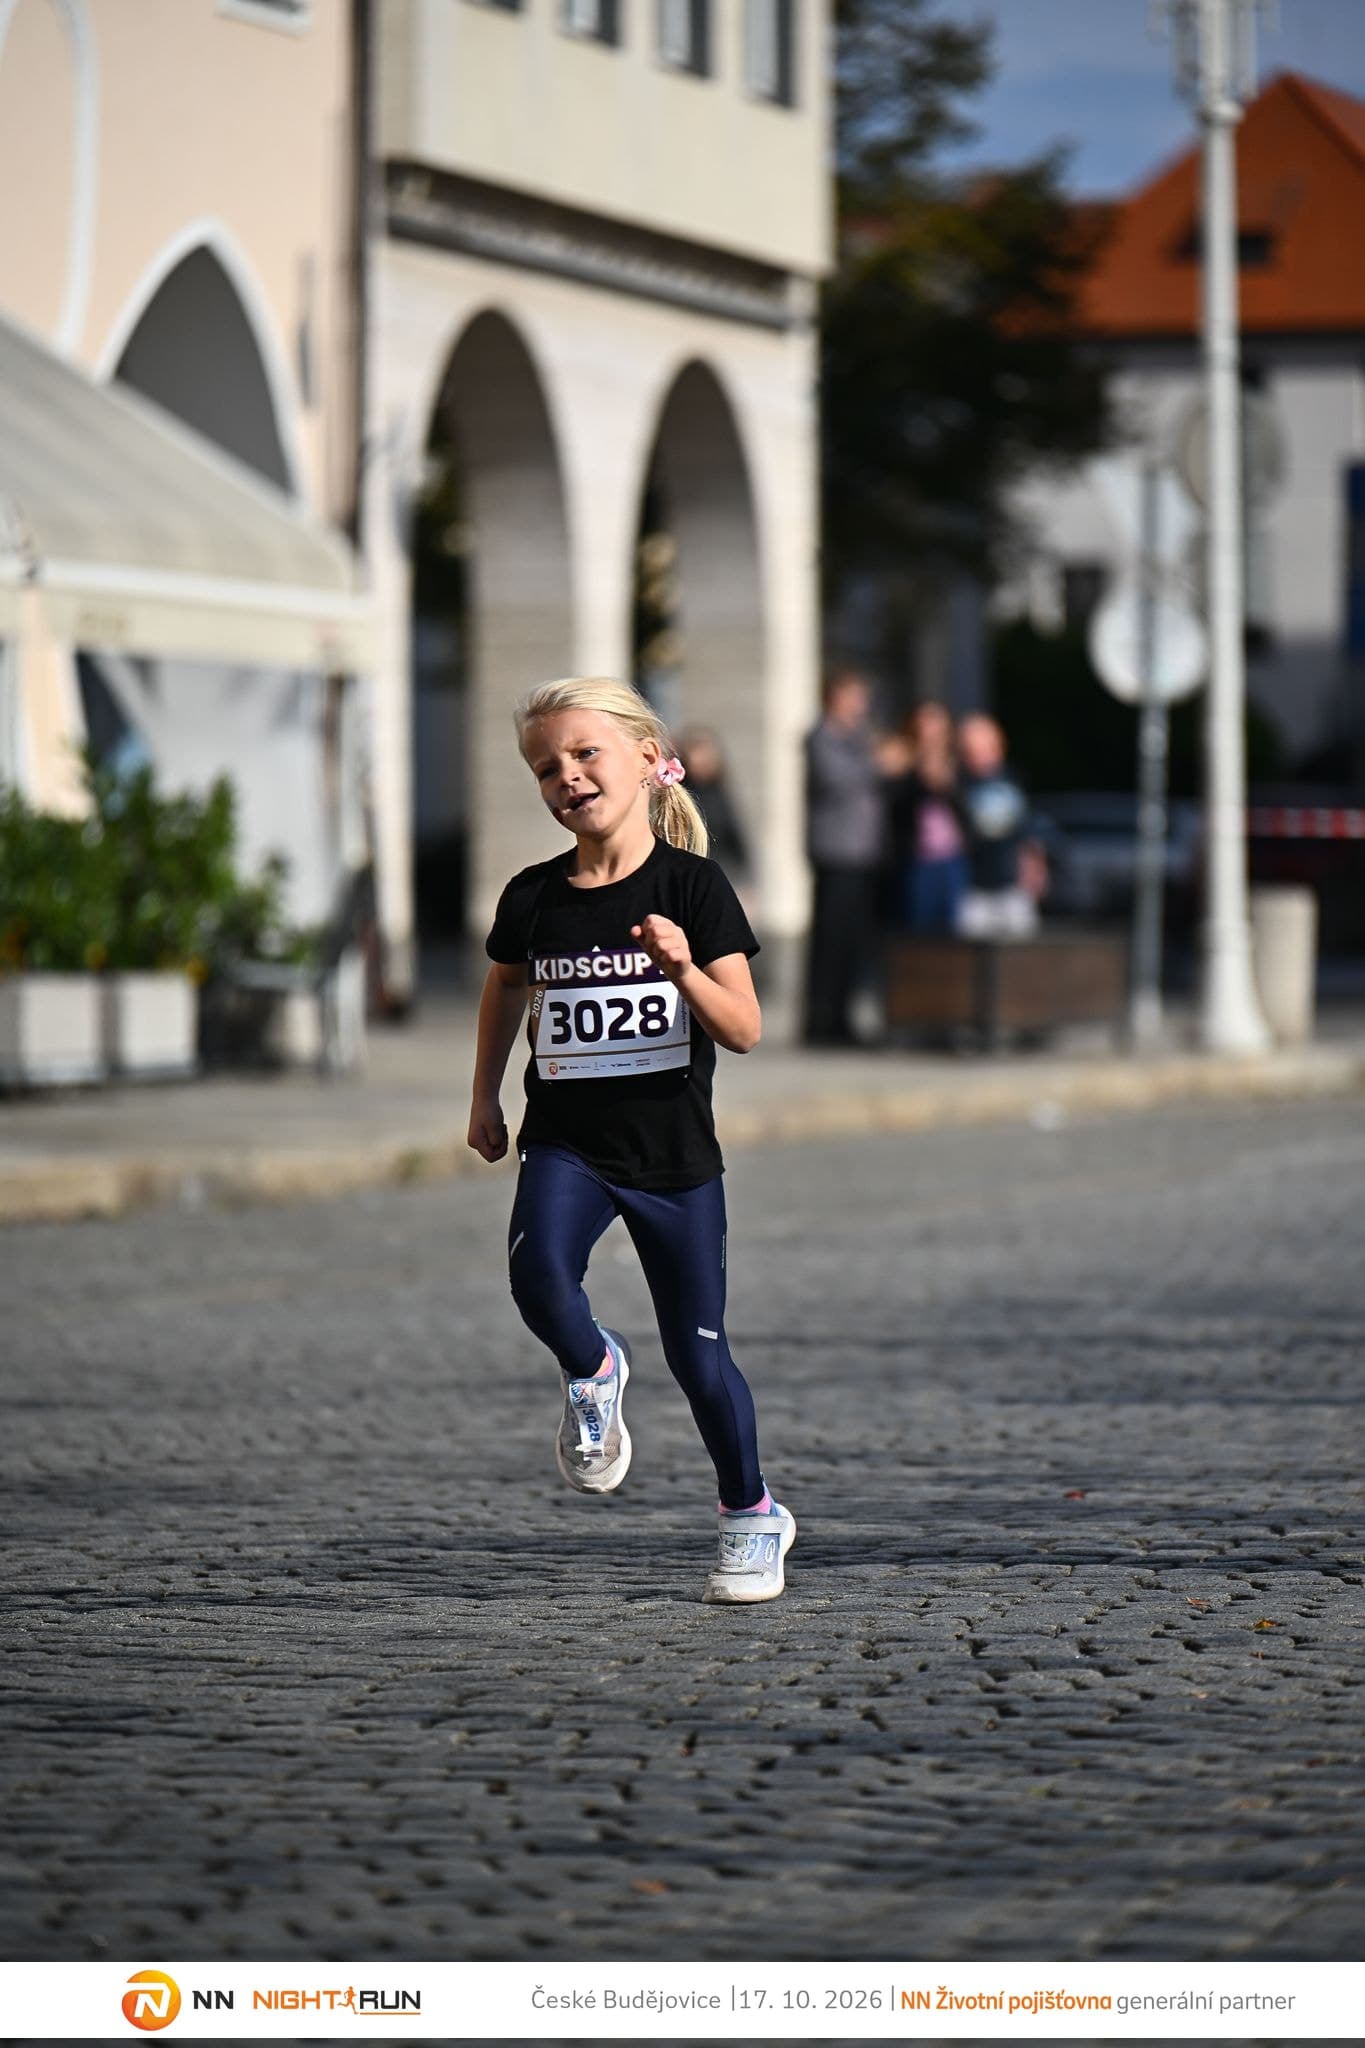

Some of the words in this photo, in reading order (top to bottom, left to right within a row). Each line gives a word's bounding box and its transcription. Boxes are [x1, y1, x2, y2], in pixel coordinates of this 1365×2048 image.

[534, 952, 653, 981] KIDSCUP
[531, 989, 543, 1018] 2026
[548, 994, 670, 1045] 3028
[582, 1408, 601, 1442] 3028
